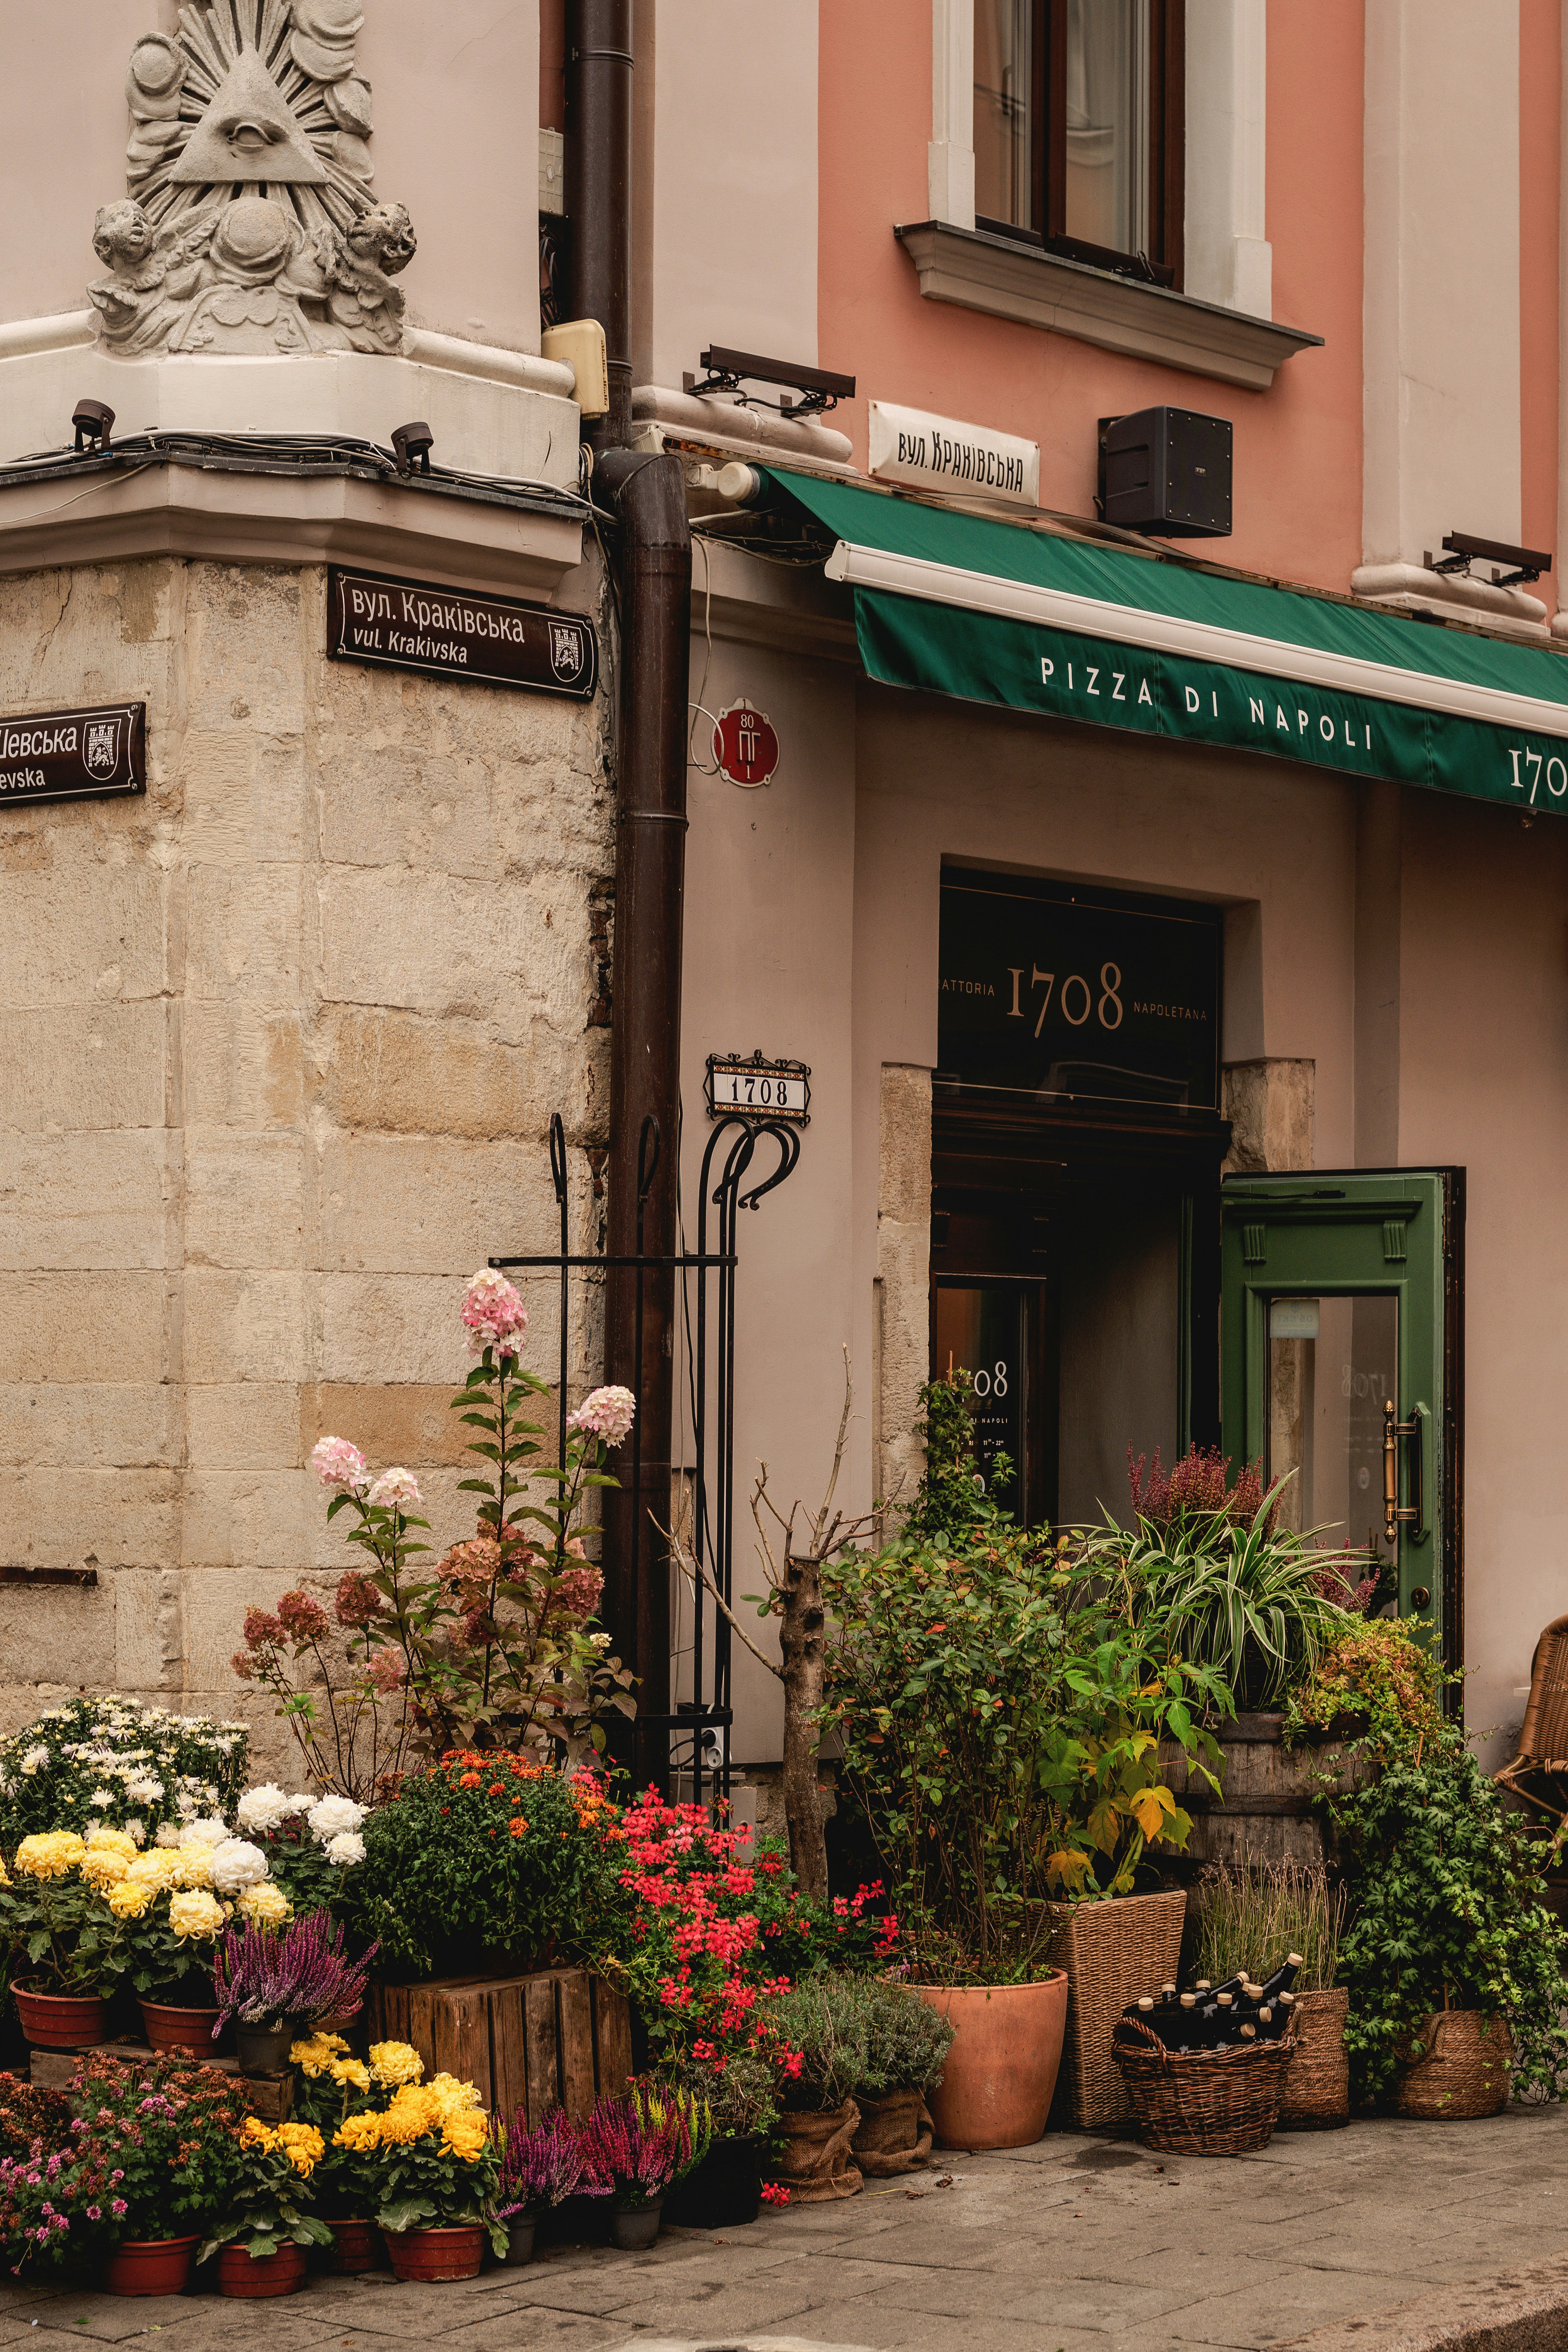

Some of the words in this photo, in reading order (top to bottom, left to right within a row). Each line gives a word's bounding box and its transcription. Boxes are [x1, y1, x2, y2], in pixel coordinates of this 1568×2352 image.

[352, 589, 396, 621] вул.
[402, 592, 525, 643] Краківська
[354, 628, 382, 649] vul.
[388, 631, 467, 664] Krakivska
[740, 714, 754, 729] 80
[1041, 657, 1153, 705] PIZZA
[1186, 686, 1218, 717] DI
[1249, 697, 1370, 749] NAPOLI
[746, 765, 751, 779] 1
[1508, 746, 1568, 804] 170
[1007, 962, 1123, 1038] 1708
[1134, 1001, 1206, 1021] NAPOLETANA
[732, 1076, 787, 1106] 1708
